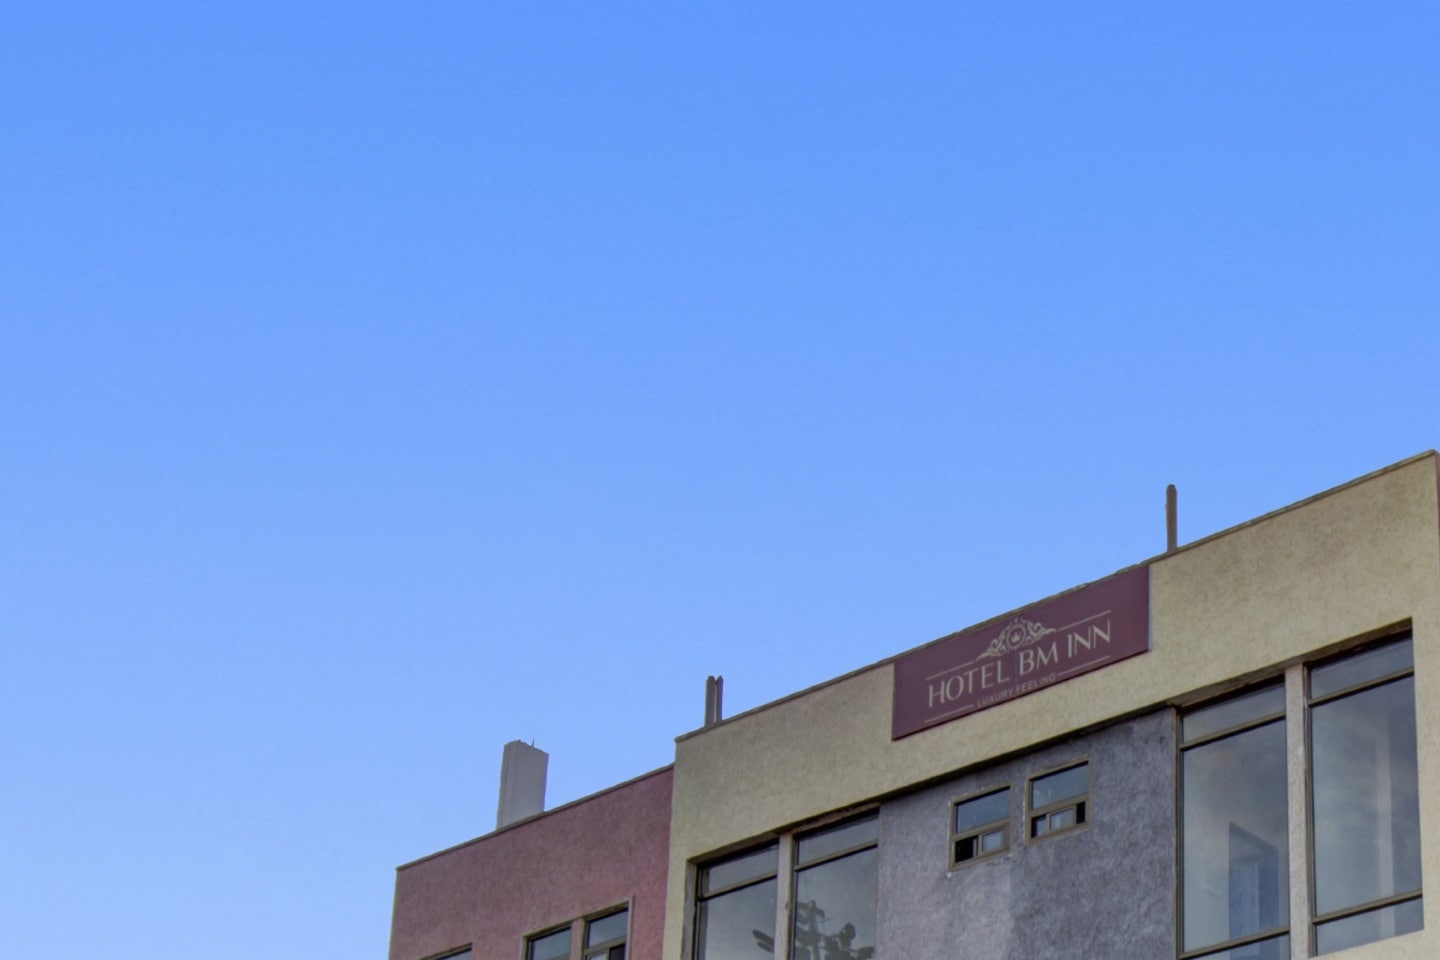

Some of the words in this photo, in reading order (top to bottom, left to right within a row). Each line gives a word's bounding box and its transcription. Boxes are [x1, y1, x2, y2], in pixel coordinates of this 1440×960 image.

[927, 660, 1010, 708] HOTEL
[1019, 640, 1059, 676] BM
[1066, 619, 1112, 658] INN
[976, 687, 1013, 707] LUXURY
[1016, 672, 1057, 693] FEELING
